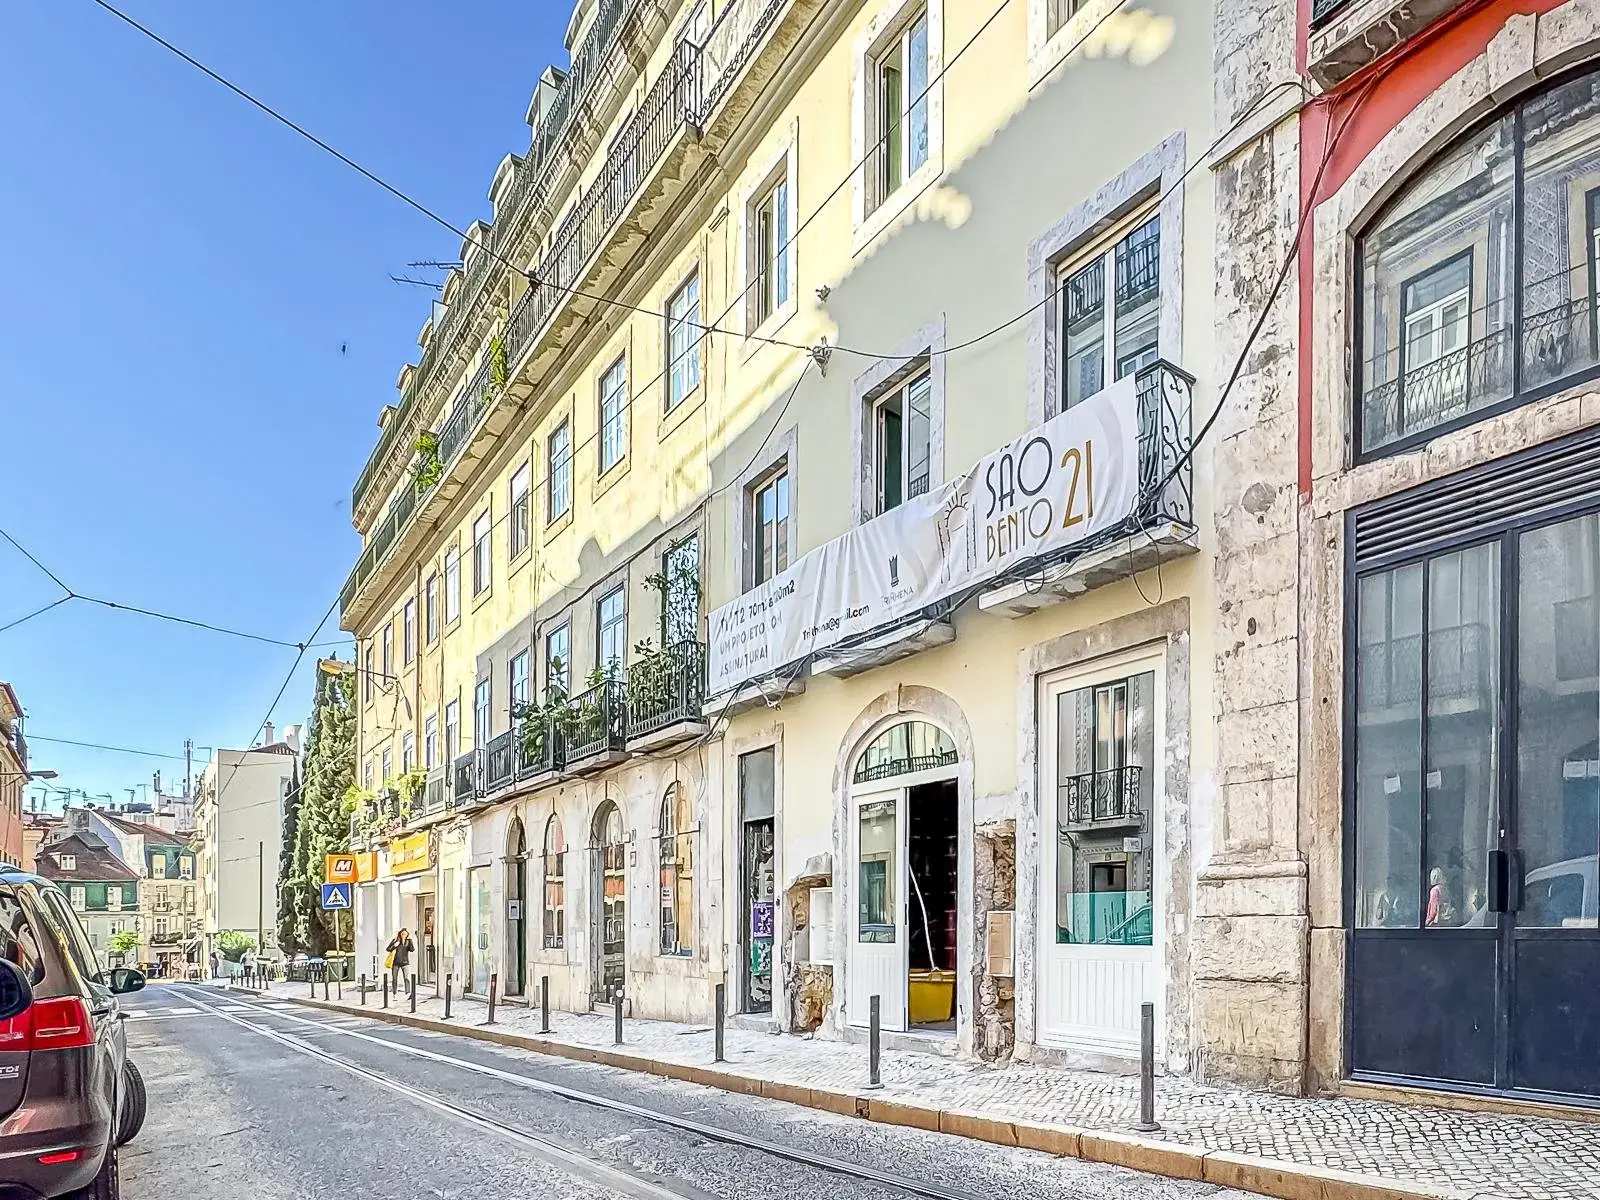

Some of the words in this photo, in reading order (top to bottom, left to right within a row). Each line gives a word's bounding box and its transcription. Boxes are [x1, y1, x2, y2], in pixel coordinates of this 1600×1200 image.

[985, 436, 1054, 519] SÃO
[1060, 440, 1094, 528] 21
[985, 498, 1053, 563] BENTO
